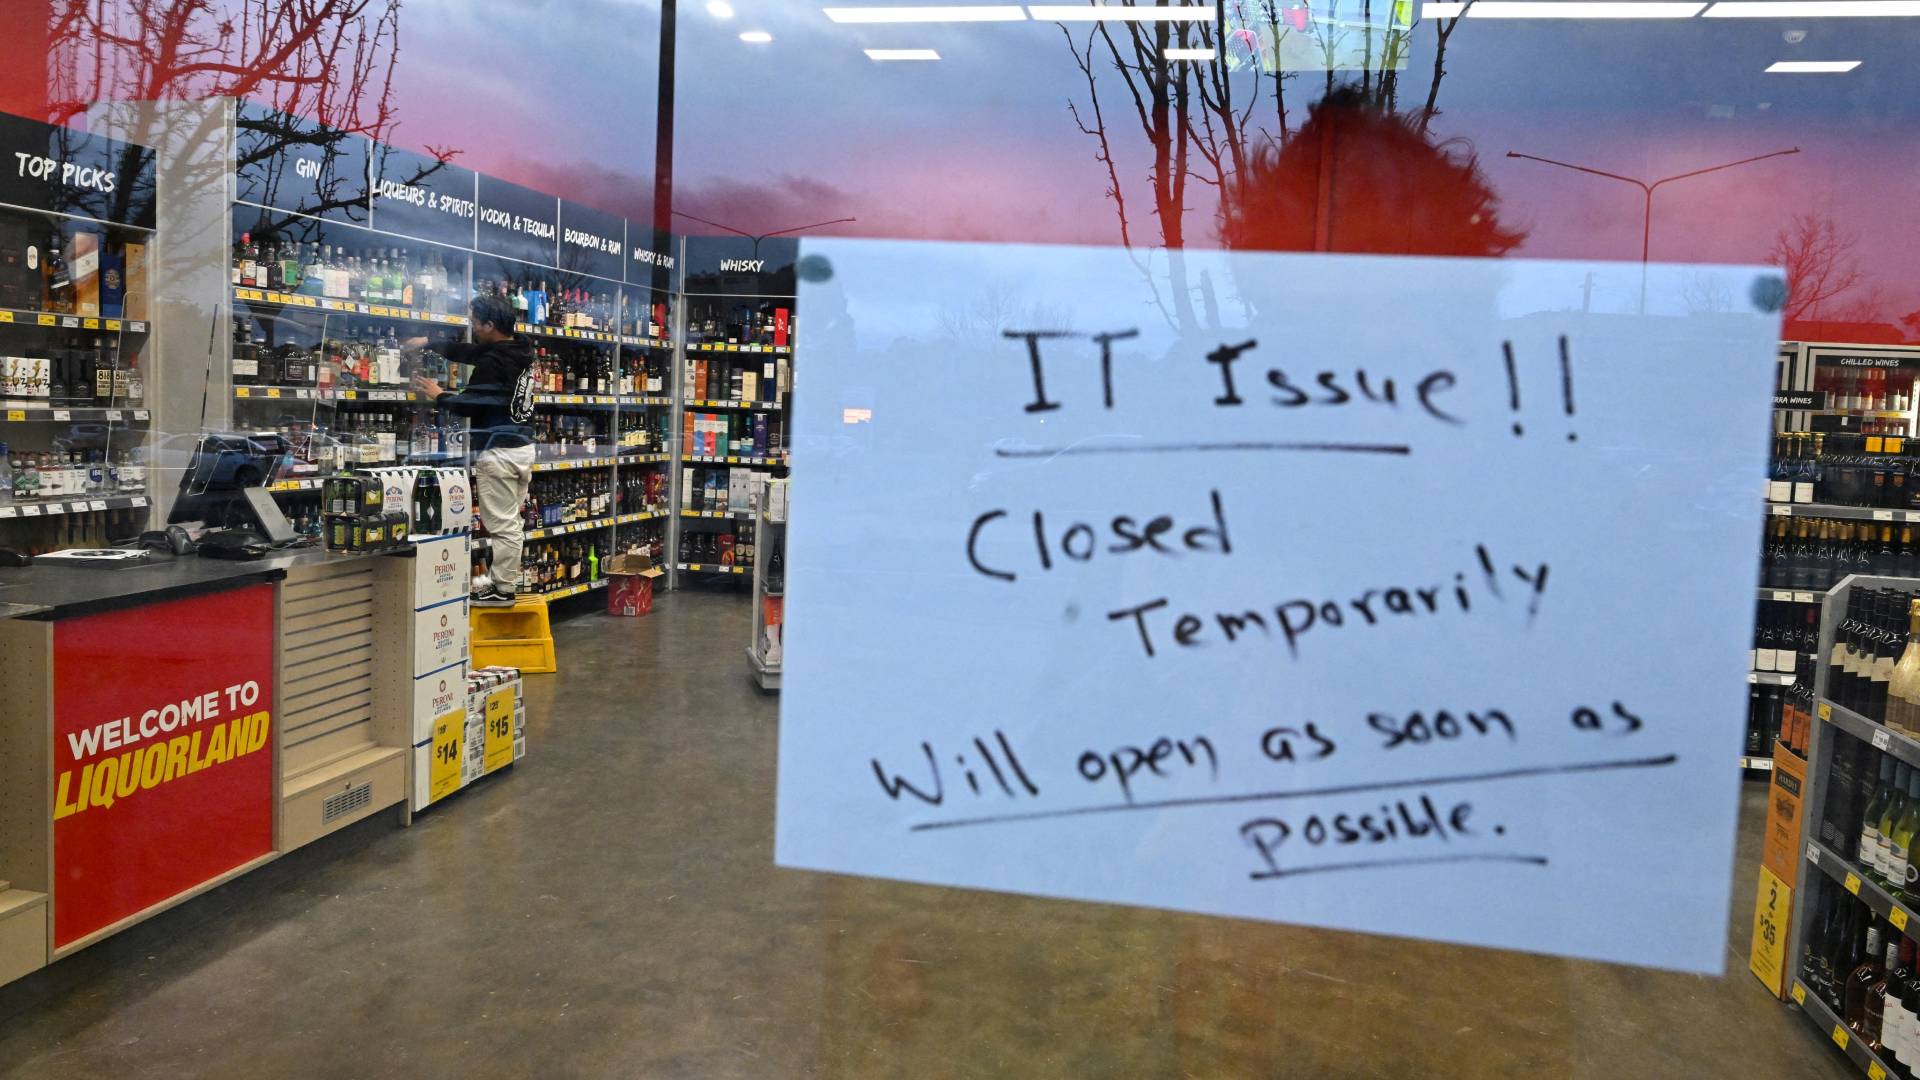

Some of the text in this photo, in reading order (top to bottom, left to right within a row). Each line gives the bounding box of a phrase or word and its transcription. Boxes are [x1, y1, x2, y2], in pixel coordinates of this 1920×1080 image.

[15, 151, 116, 193] TOP PICKS
[296, 158, 321, 180] GIN
[372, 177, 475, 219] LIQUEURS & SPIRITS
[480, 206, 555, 241] VODKA & TEQUILA
[564, 228, 621, 255] BOURBON & RUM
[634, 247, 675, 270] WHISKY & RUM
[720, 258, 765, 273] WHISKY
[1002, 328, 1140, 415] IT
[1840, 358, 1900, 367] CHILLED WINES
[1790, 397, 1812, 405] WINES
[966, 489, 1233, 582] Closed
[434, 563, 456, 576] PERONI
[1107, 544, 1550, 660] Temporarily
[433, 628, 455, 642] PERONI
[432, 692, 454, 707] PERONI
[67, 680, 260, 761] WELCOME TO
[490, 714, 509, 739] $15
[436, 738, 458, 765] $14
[870, 699, 1644, 806] Will open as soon as
[53, 710, 270, 821] LIQUORLAND
[1238, 797, 1507, 864] possible.
[1768, 887, 1777, 911] 2
[1759, 913, 1776, 946] $35
